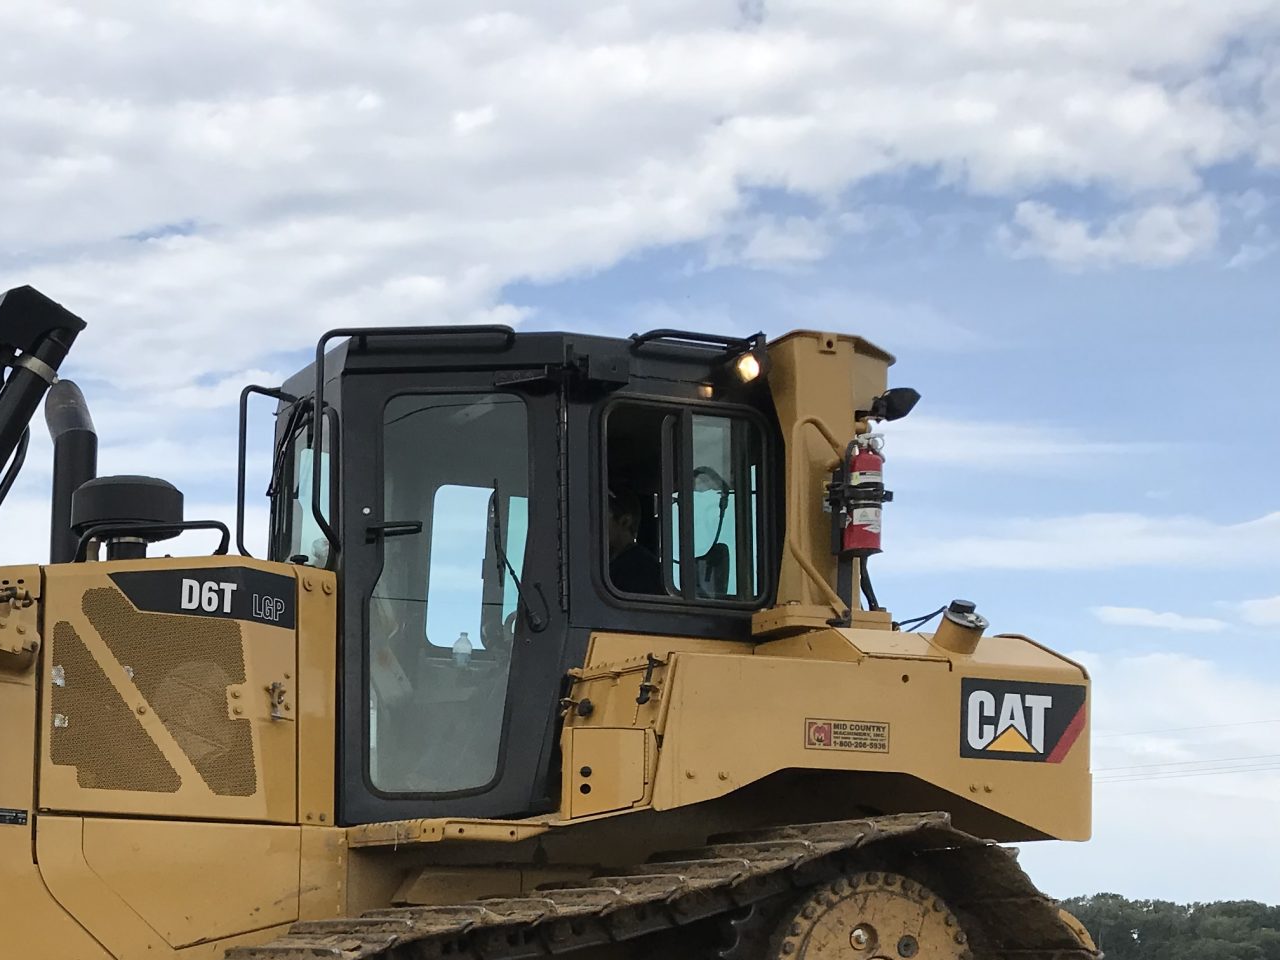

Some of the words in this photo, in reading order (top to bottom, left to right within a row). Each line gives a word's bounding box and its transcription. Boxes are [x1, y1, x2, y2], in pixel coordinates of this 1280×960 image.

[181, 578, 237, 613] D6T
[252, 594, 285, 622] LGP
[849, 724, 886, 732] COUNTRY
[967, 690, 1053, 754] CAT
